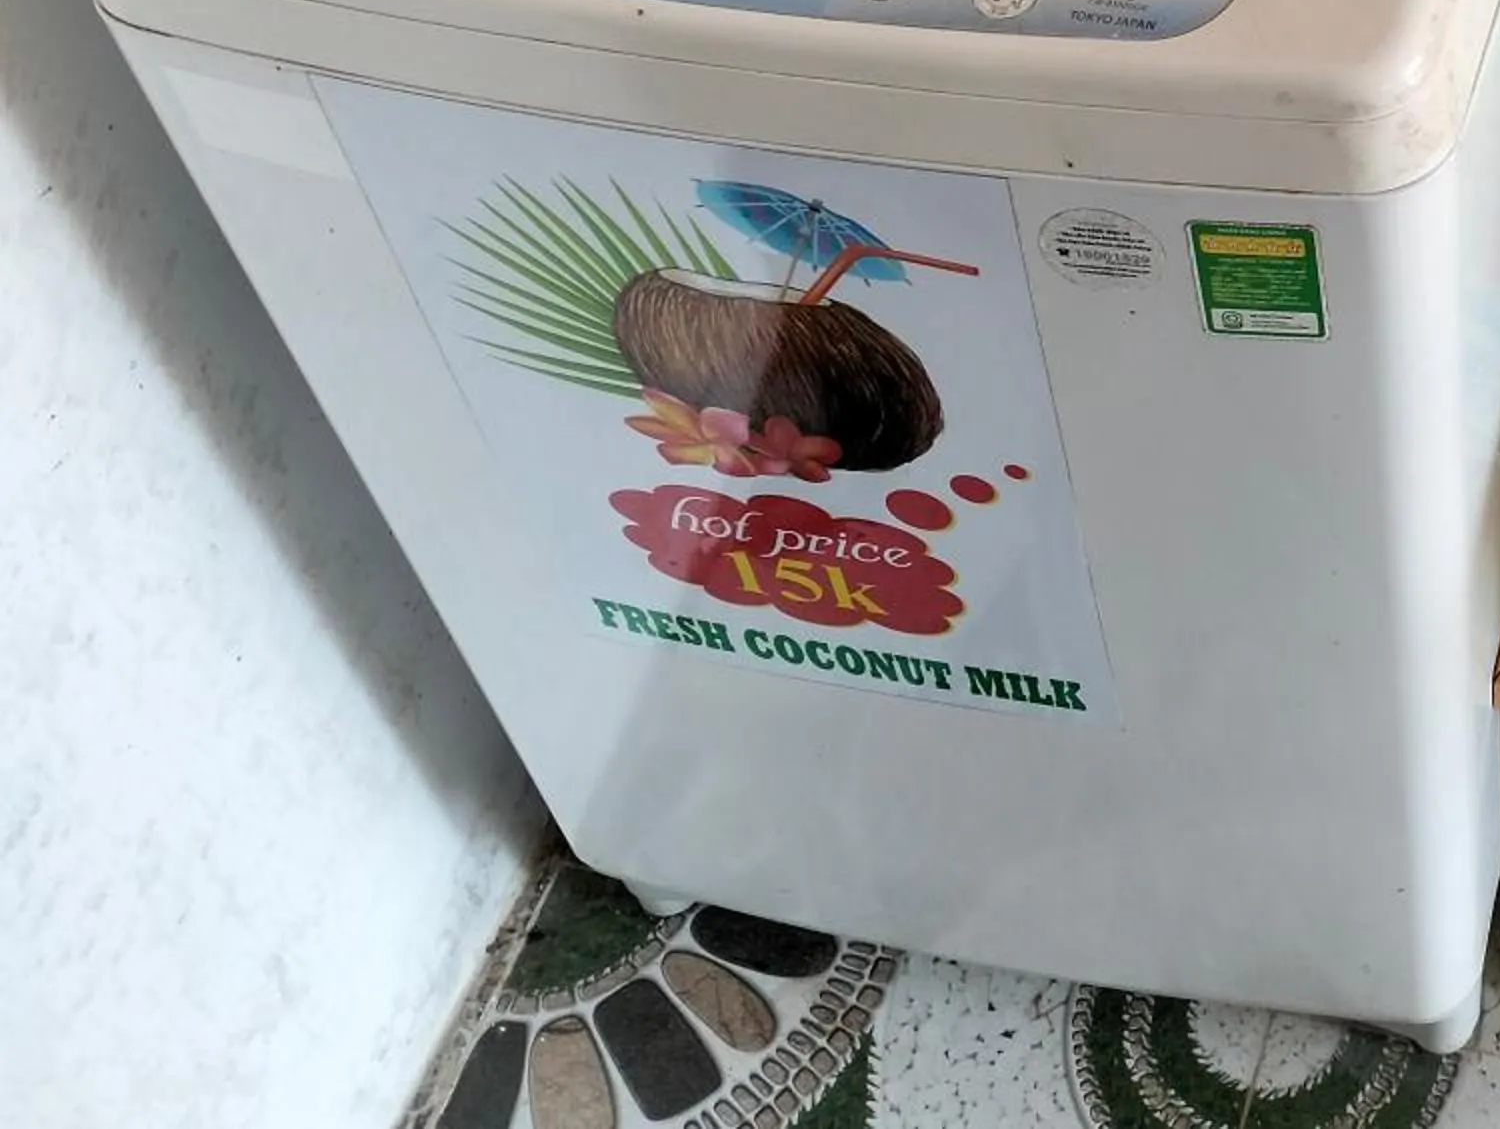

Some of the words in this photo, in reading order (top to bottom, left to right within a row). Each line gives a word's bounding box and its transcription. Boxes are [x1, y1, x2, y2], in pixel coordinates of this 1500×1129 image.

[1071, 10, 1113, 25] TOKYO
[1115, 16, 1158, 31] JAPAN
[671, 496, 763, 543] hot
[767, 527, 913, 569] price
[724, 549, 889, 617] 15k
[592, 597, 736, 653] FRESH
[744, 628, 952, 691] COCONUT
[963, 665, 1087, 712] MILK
